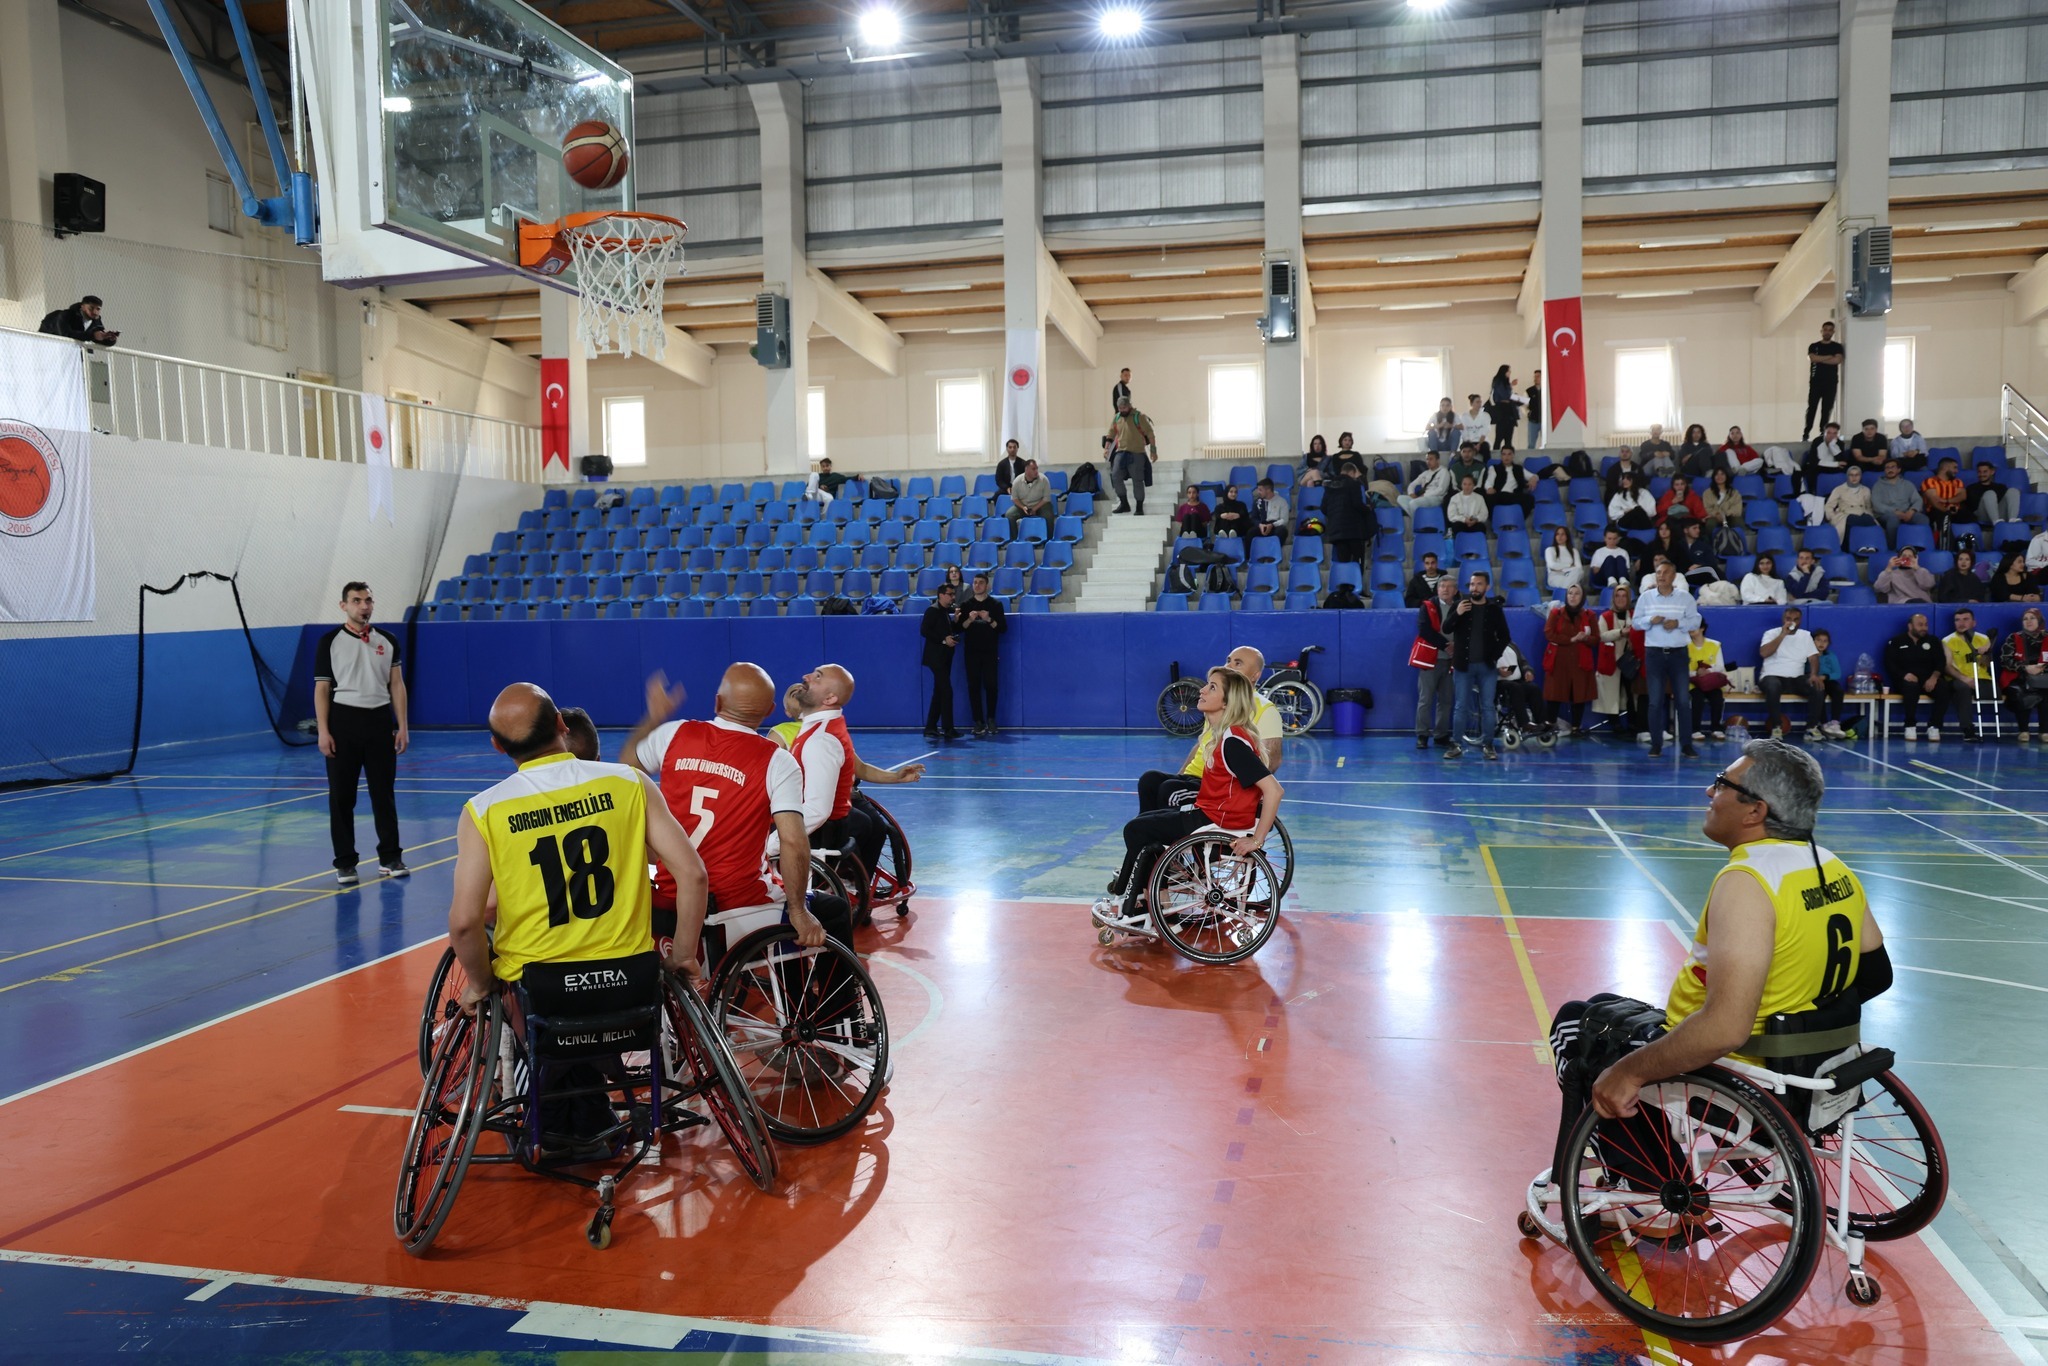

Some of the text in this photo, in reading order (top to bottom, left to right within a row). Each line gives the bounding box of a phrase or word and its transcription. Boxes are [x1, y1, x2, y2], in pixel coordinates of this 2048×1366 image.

[8, 522, 32, 533] 2006
[675, 758, 700, 771] BOZOK
[508, 792, 614, 833] SORGUN ENGELLİLER
[690, 785, 719, 850] 5
[529, 825, 614, 928] 18
[1819, 913, 1853, 998] 6
[564, 969, 627, 986] EXTRA
[582, 981, 628, 991] WHEELCHAIR
